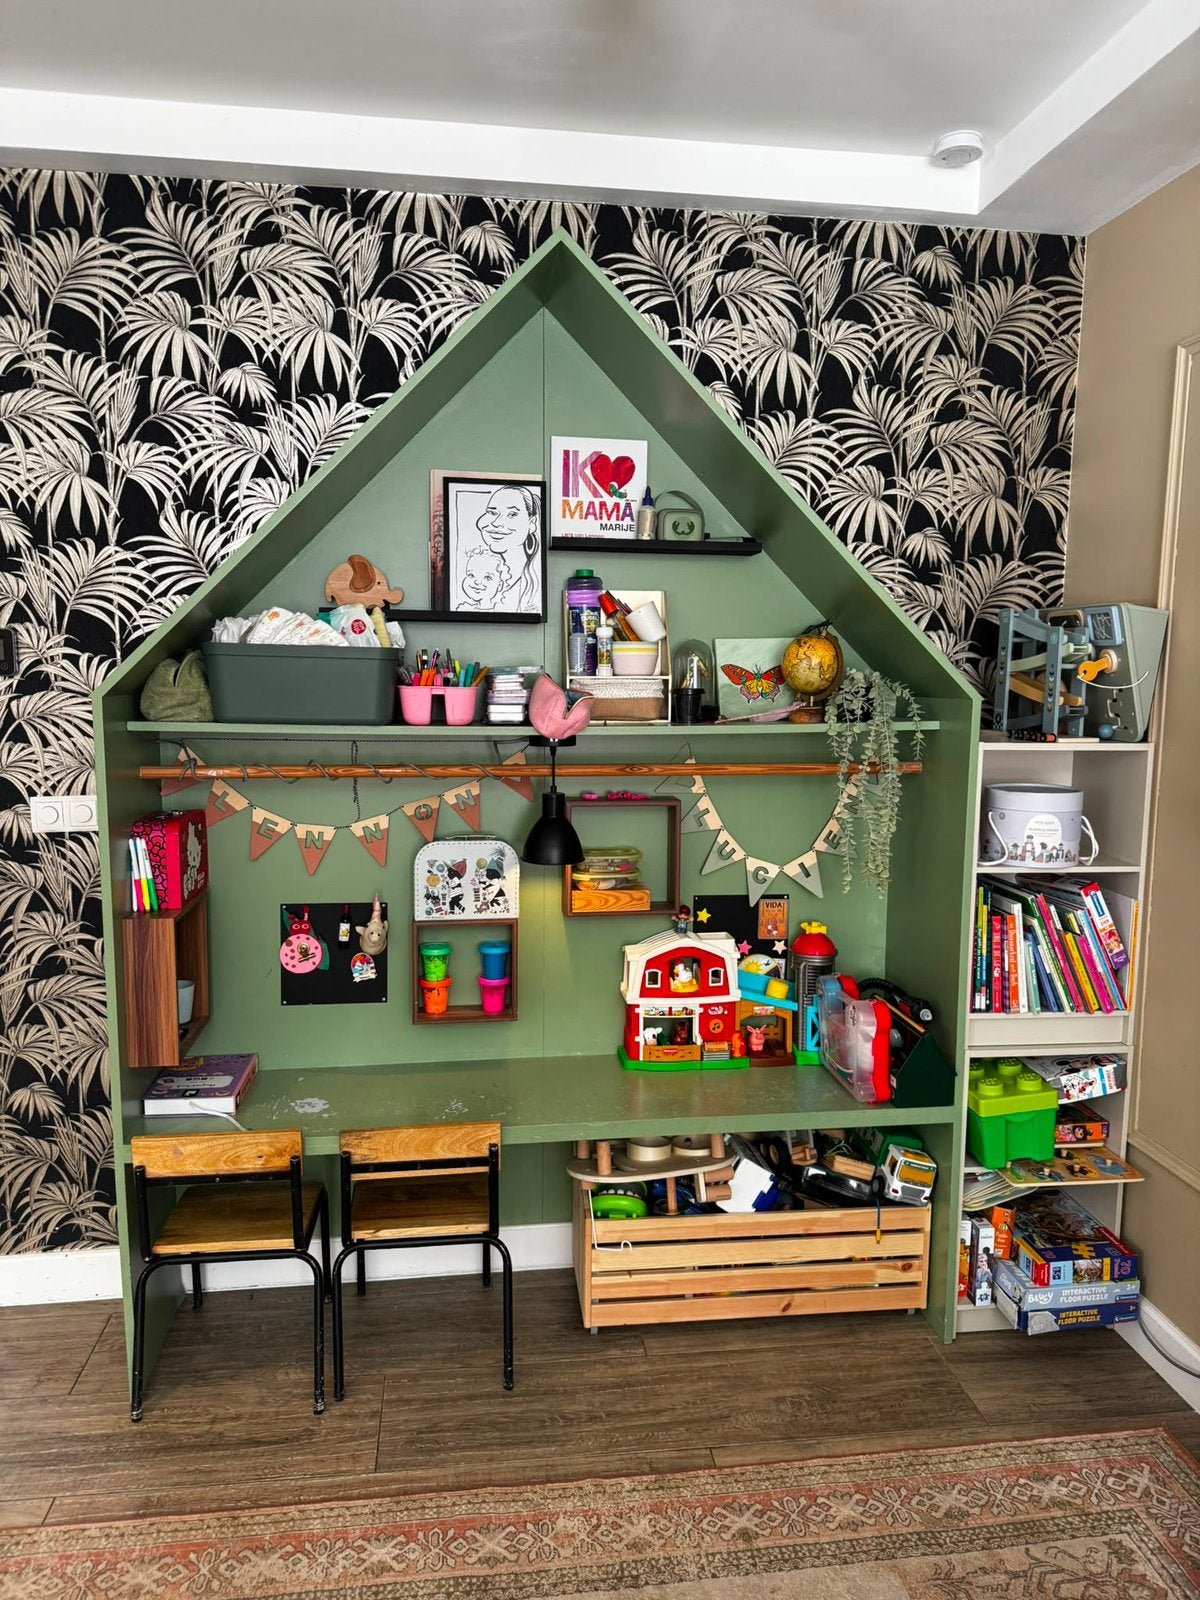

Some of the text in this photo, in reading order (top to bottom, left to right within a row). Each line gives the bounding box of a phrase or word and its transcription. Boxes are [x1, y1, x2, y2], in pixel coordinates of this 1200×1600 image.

[562, 449, 603, 498] IK
[561, 499, 635, 522] MAMA
[599, 523, 635, 532] MARIJE
[765, 901, 782, 909] VIDA
[1082, 1294, 1109, 1302] PUZZLE
[1059, 1309, 1098, 1319] INTERACTIVE
[1058, 1315, 1101, 1326] FLOOR PUZZLE
